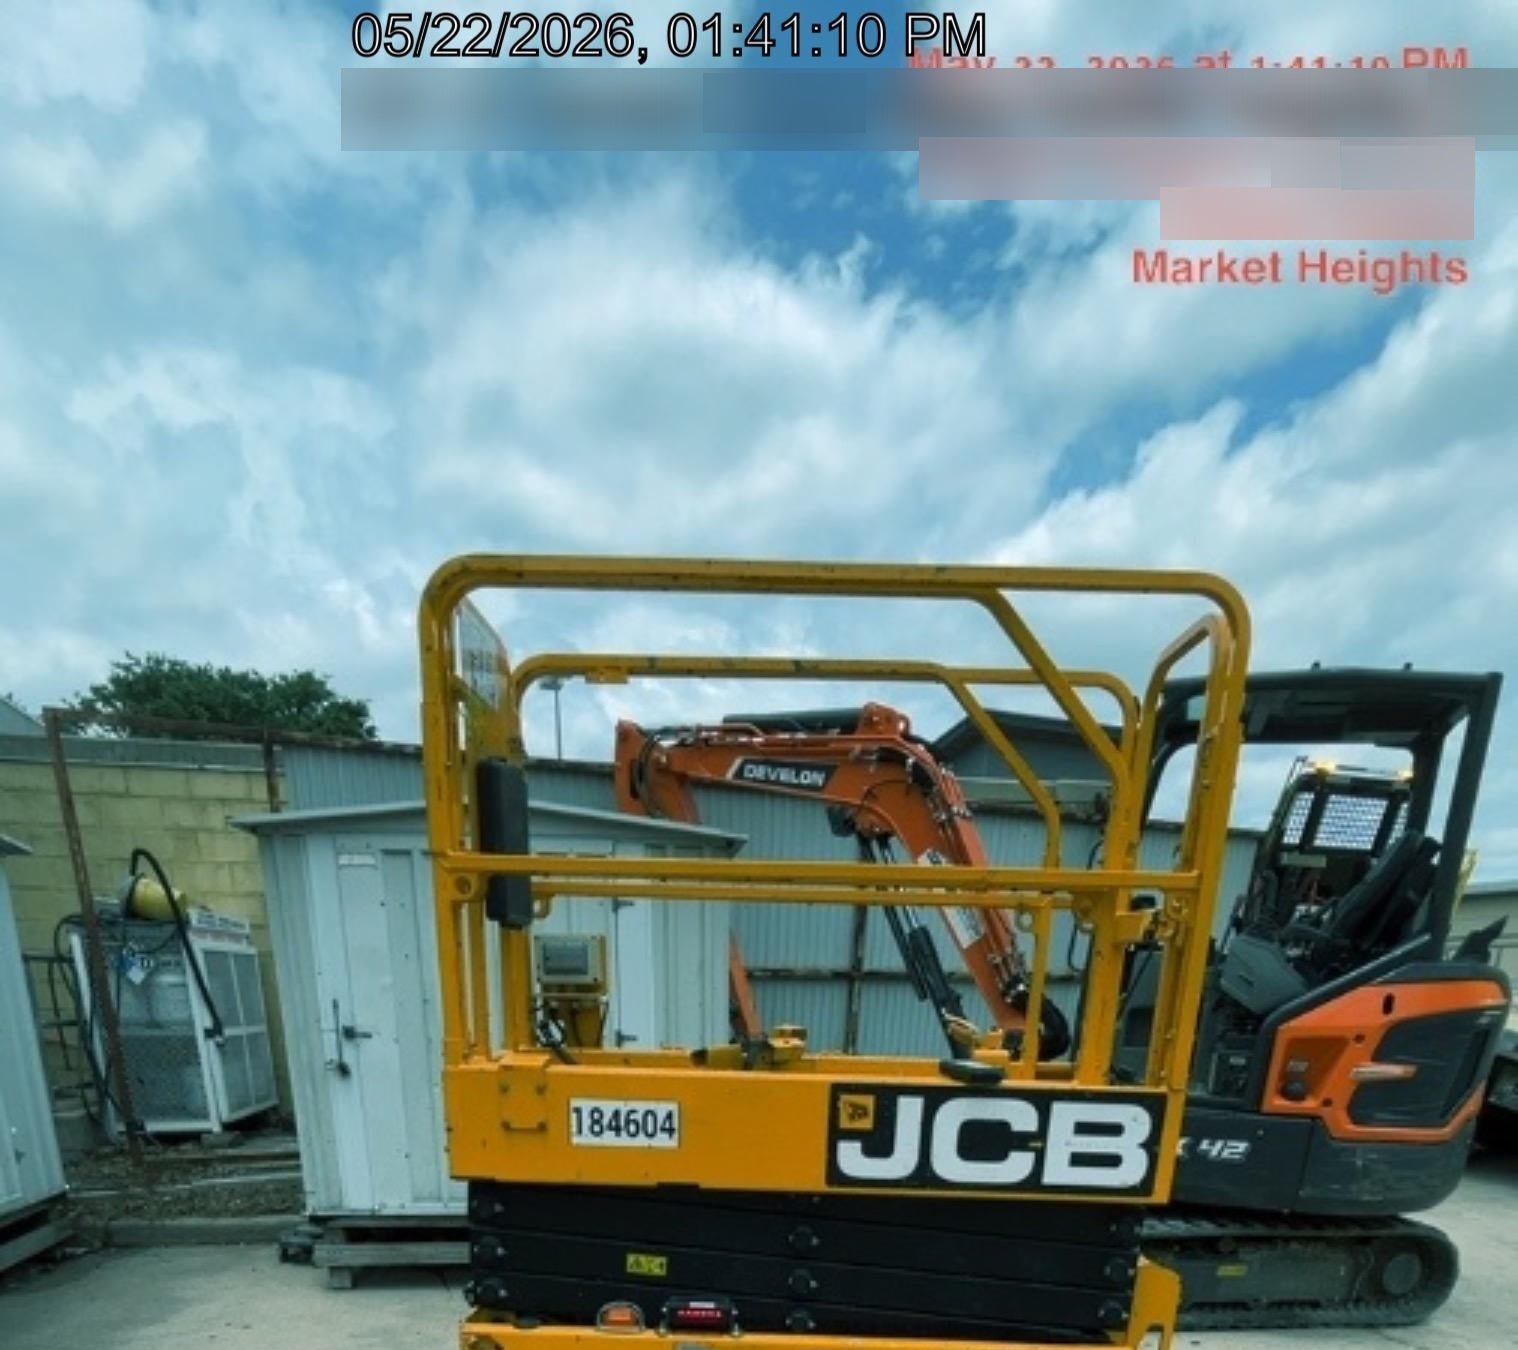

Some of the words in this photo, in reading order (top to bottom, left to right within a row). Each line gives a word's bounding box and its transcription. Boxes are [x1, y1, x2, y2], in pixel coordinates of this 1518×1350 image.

[743, 763, 826, 787] DEVELON
[572, 1106, 676, 1140] 184604
[836, 1095, 1152, 1189] JCB
[1198, 1139, 1250, 1160] 42
